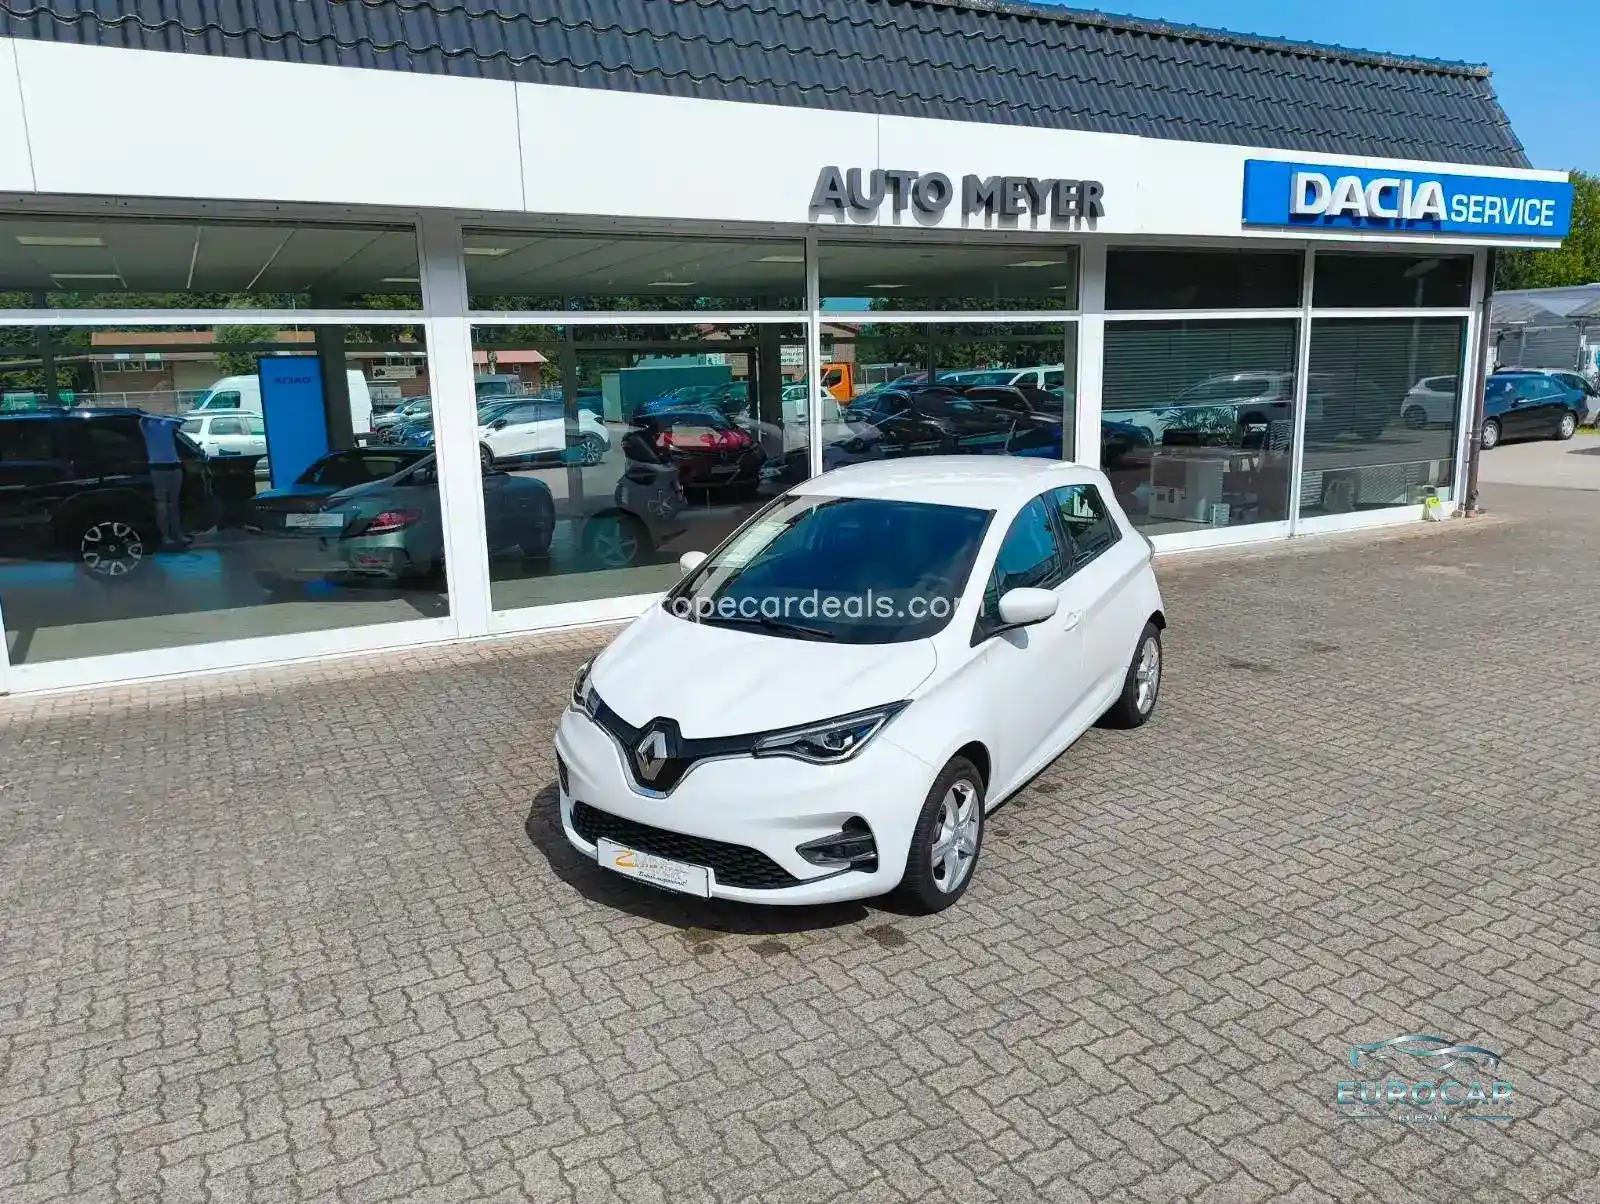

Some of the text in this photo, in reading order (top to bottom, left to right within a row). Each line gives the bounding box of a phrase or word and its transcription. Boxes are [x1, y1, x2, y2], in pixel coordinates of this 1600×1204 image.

[810, 165, 1105, 217] AUTO MEYER
[1290, 171, 1555, 227] DACIA SERVICE
